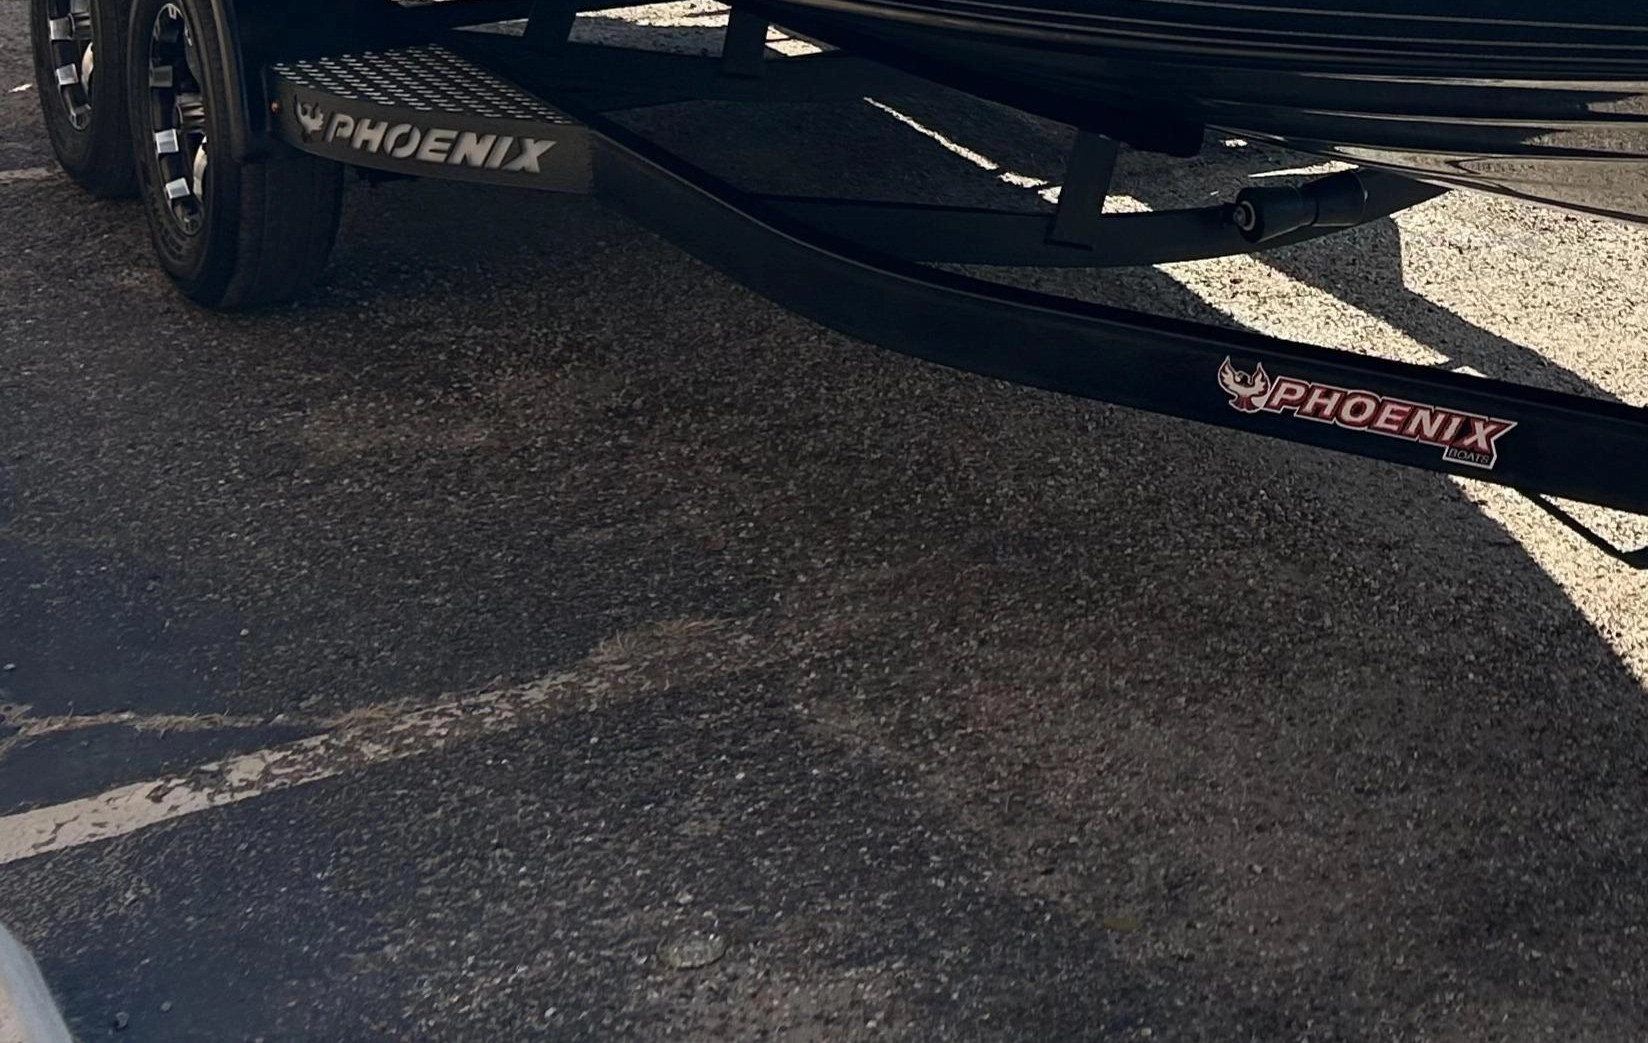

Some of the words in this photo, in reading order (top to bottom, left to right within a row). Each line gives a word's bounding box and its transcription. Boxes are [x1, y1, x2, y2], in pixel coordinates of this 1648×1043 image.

[323, 112, 557, 173] PHOENIX
[1264, 376, 1515, 452] PHOENIX
[1448, 447, 1490, 464] BOATS
